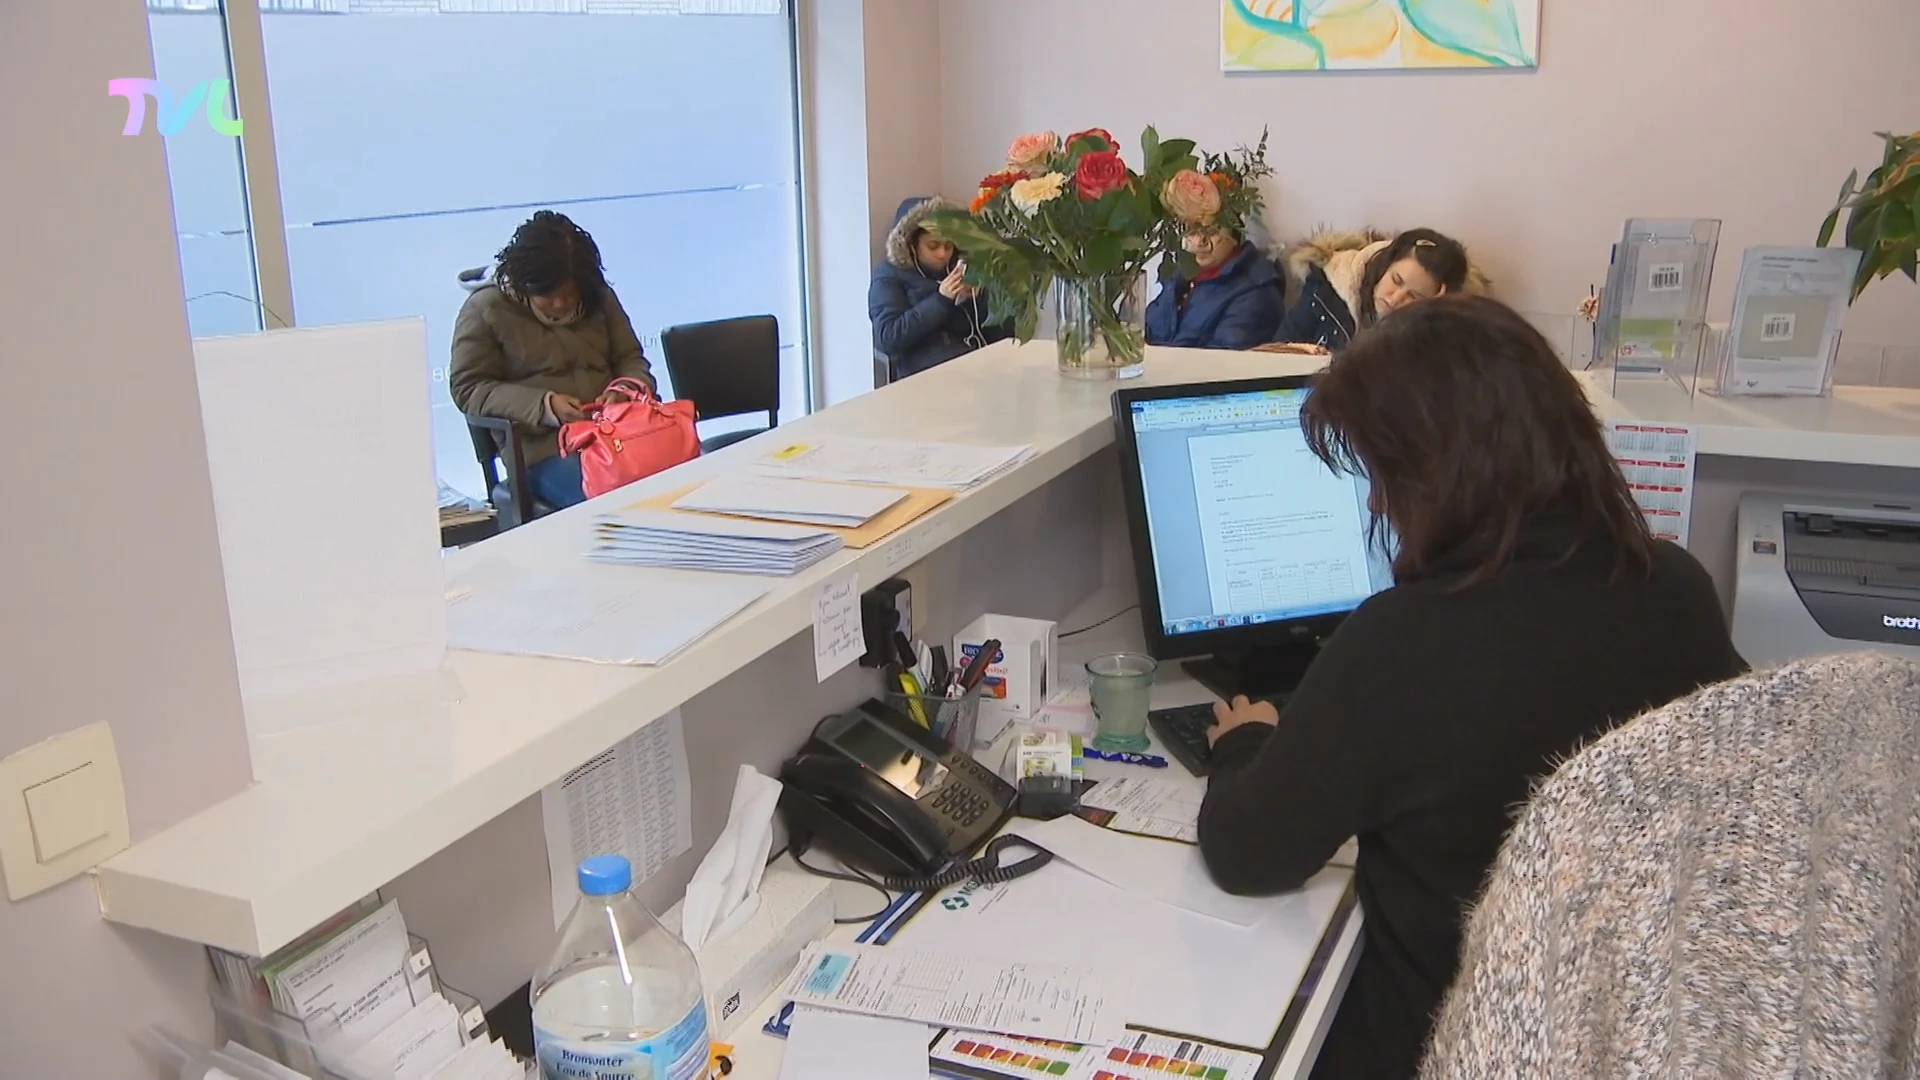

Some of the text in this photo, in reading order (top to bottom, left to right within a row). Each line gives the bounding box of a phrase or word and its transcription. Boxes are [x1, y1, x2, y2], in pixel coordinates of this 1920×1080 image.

[562, 1049, 624, 1067] Bronwater
[556, 1061, 635, 1080] Eau de Source
